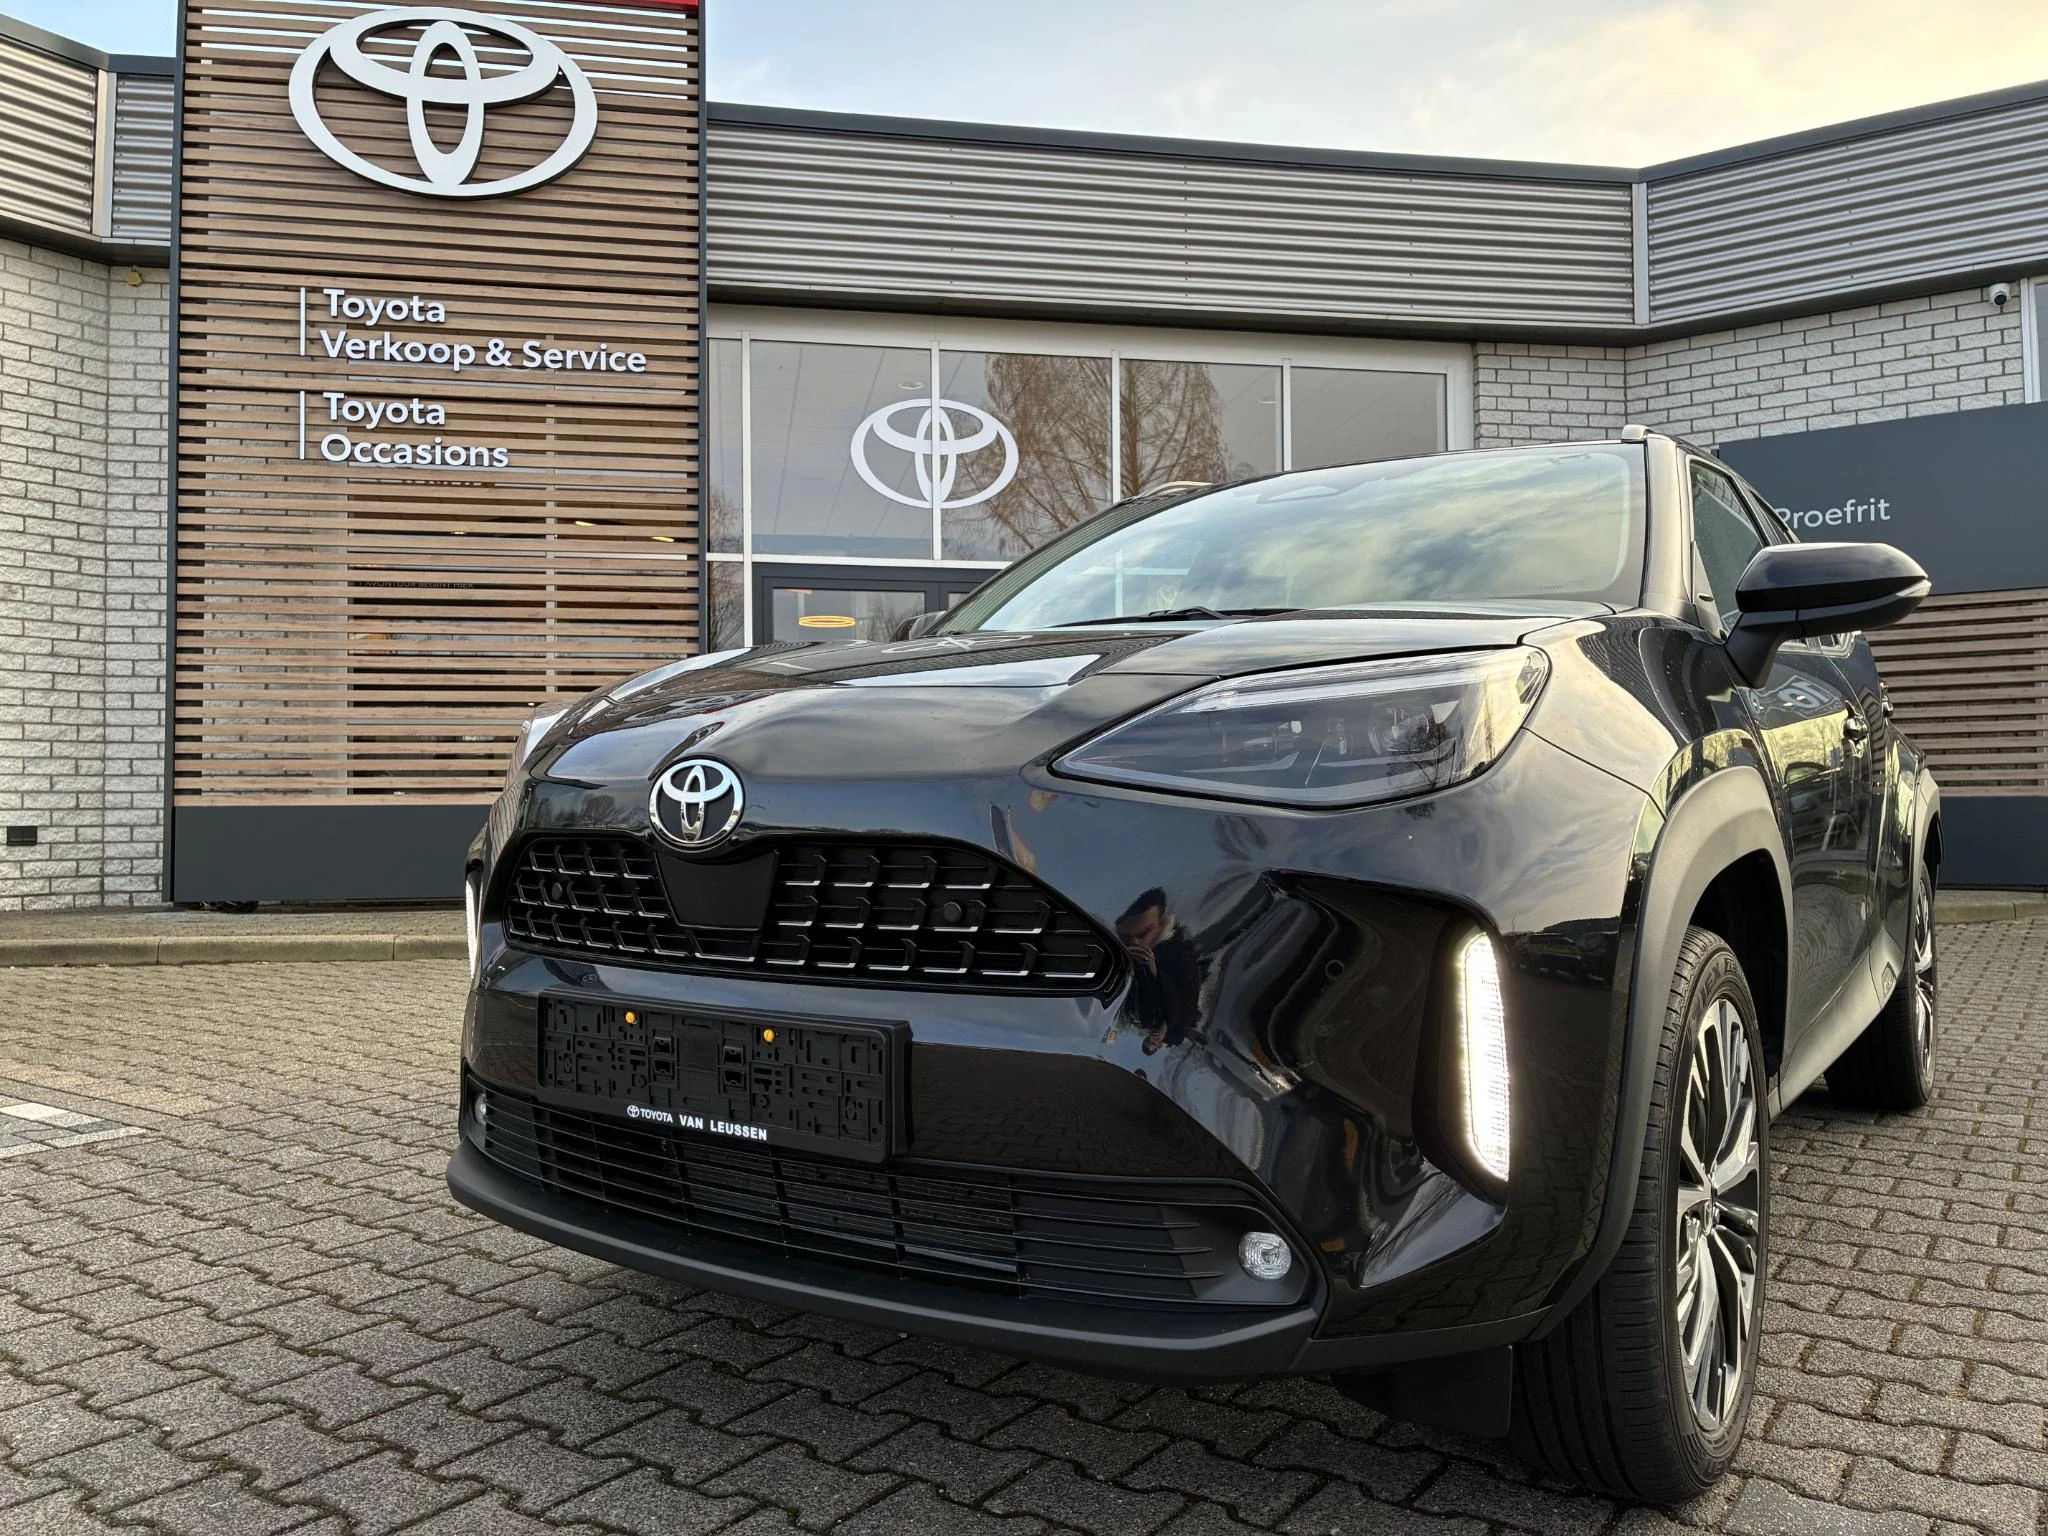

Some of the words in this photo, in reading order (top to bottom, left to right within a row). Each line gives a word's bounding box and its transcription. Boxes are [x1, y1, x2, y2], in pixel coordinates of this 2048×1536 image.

[322, 288, 446, 326] Toyota
[320, 329, 476, 372] Verkoop
[485, 338, 513, 367] &
[522, 340, 647, 373] Service
[322, 391, 446, 430] Toyota
[320, 433, 509, 468] Occasions
[1774, 497, 1891, 529] Proefrit
[639, 1108, 674, 1123] TOYOTA
[679, 1114, 704, 1130] VAN
[710, 1119, 768, 1141] LEUSSEN
